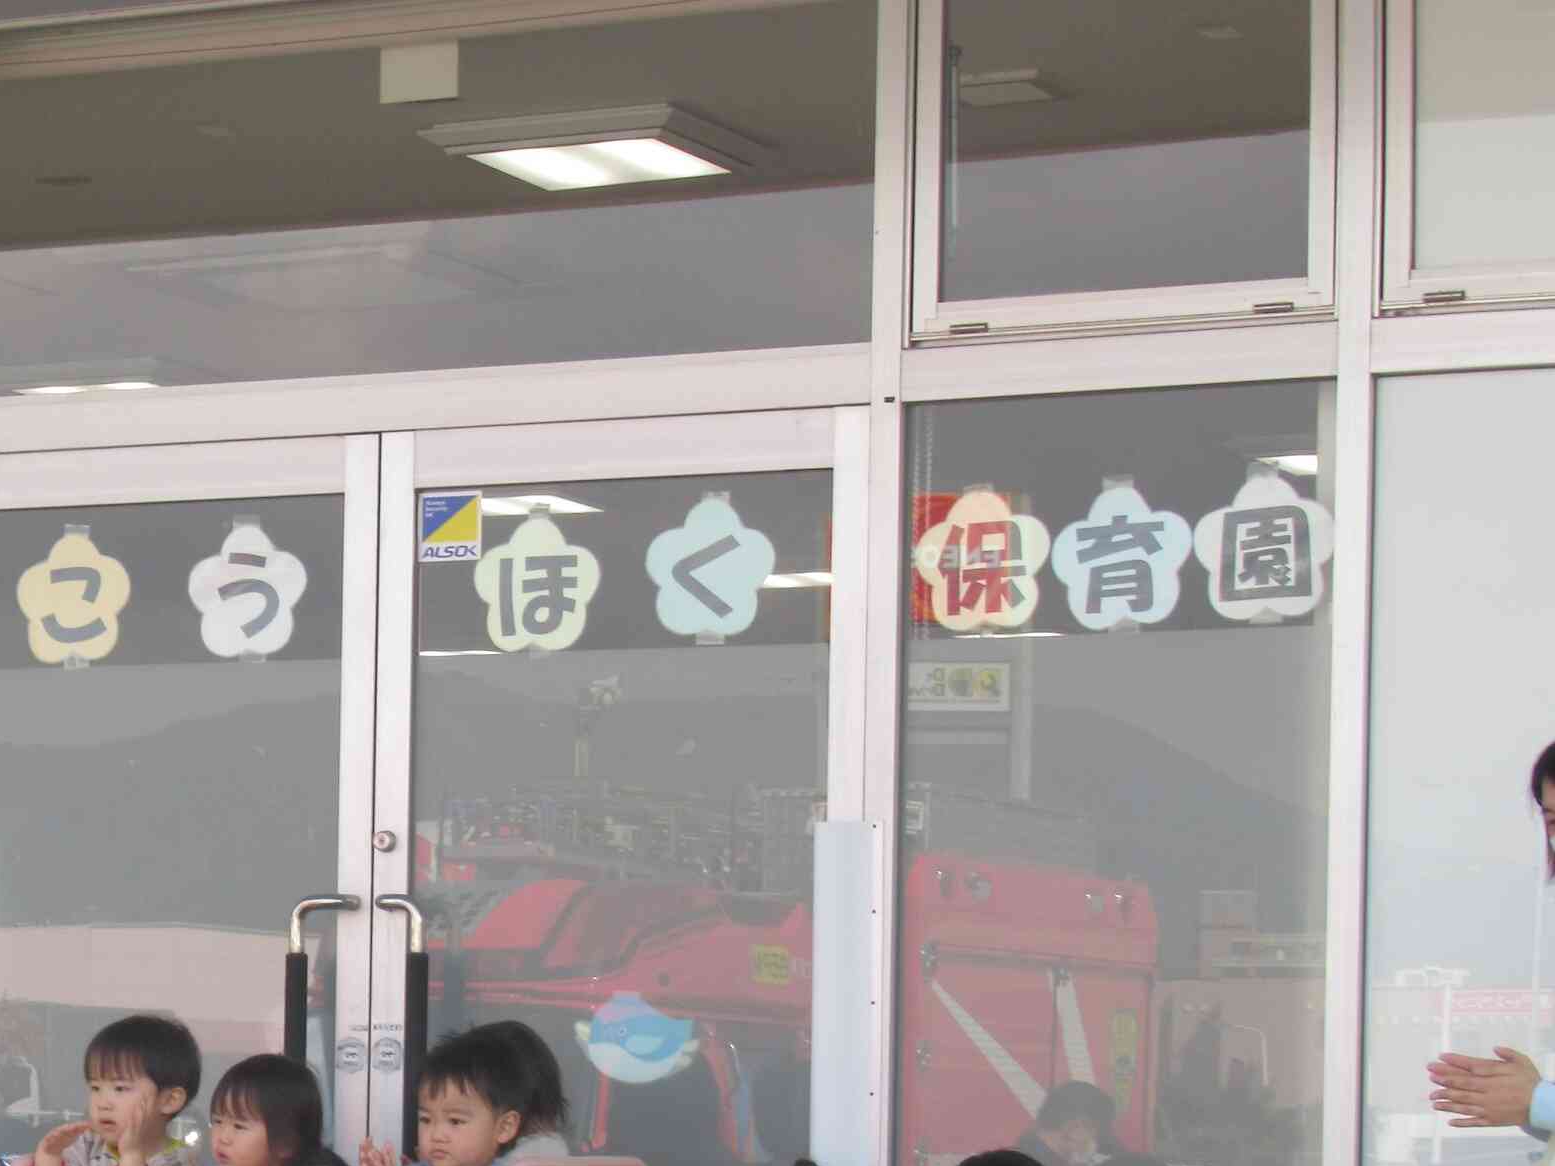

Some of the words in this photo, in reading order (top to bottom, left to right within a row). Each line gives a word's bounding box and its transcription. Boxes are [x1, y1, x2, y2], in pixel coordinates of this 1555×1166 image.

[422, 546, 477, 559] ALSOK
[937, 505, 1312, 616] 保育園
